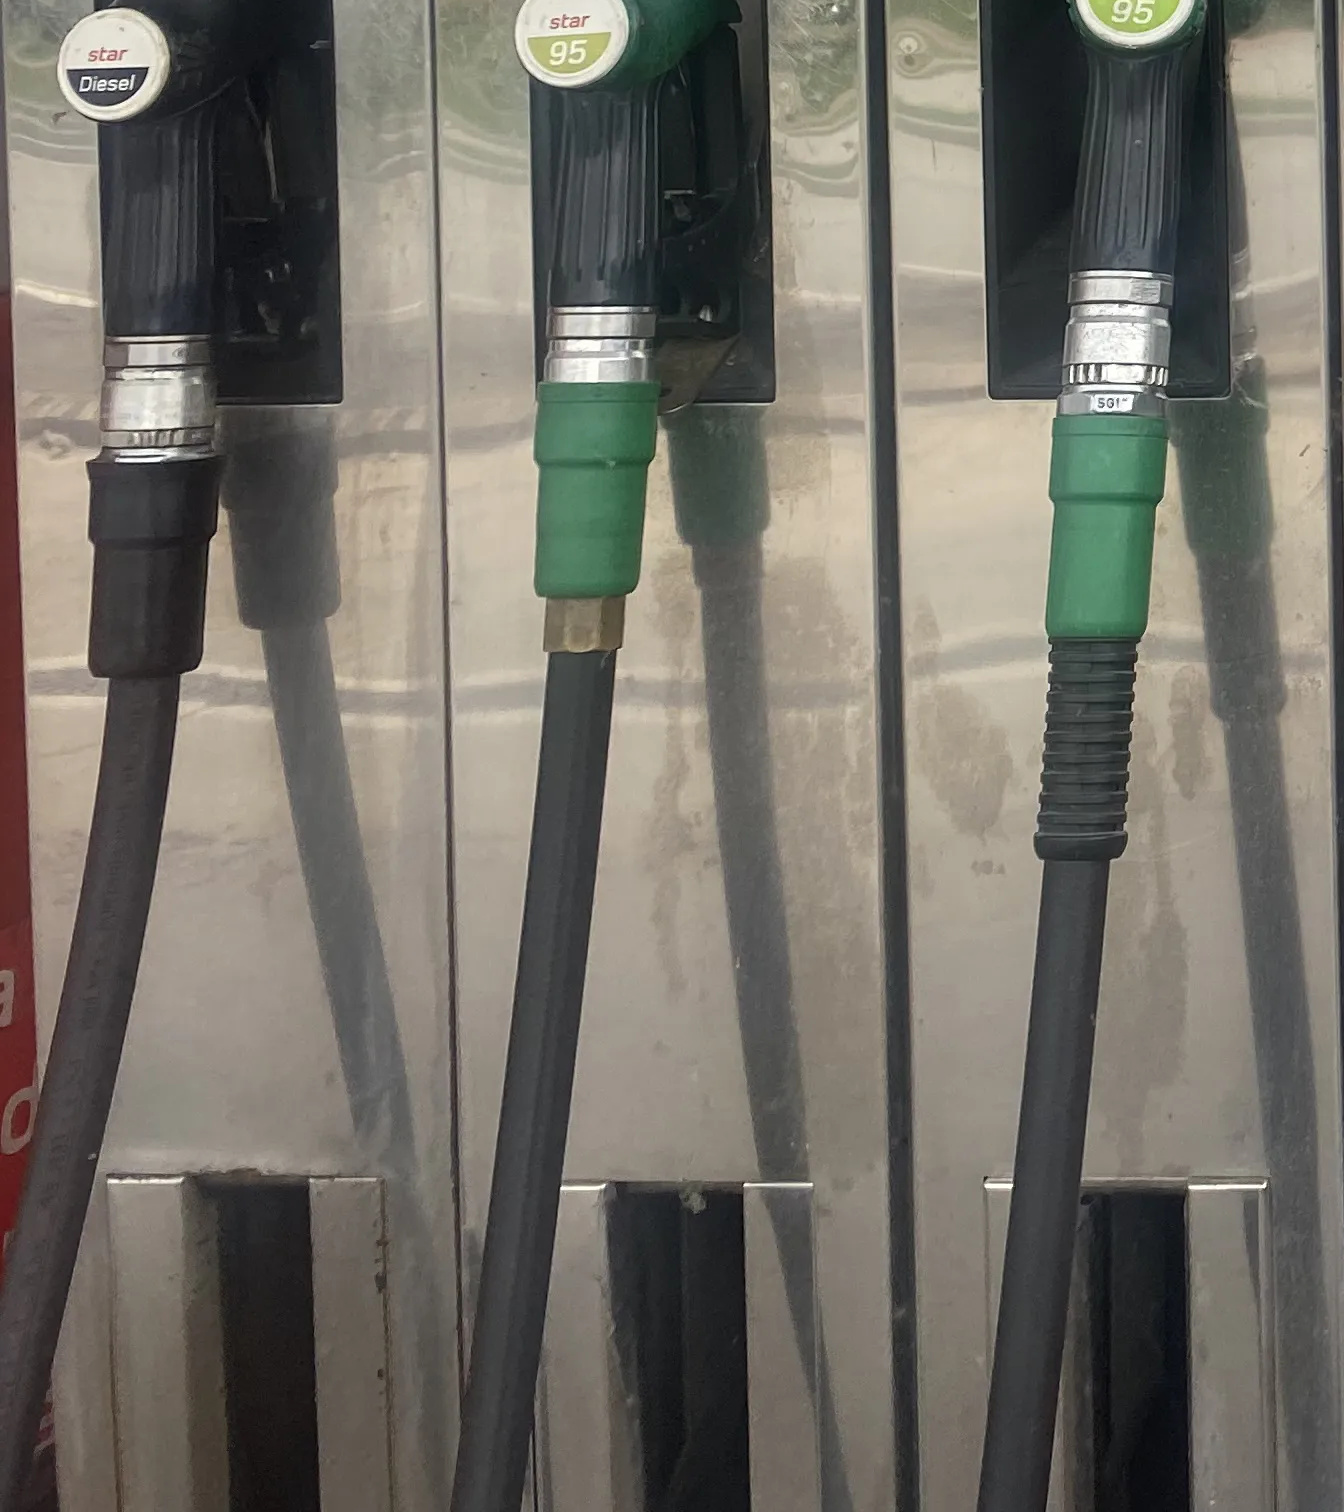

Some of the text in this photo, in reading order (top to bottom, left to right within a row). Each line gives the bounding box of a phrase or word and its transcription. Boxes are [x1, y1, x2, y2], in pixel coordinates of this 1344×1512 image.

[548, 13, 591, 29] star
[87, 47, 128, 62] star
[548, 39, 588, 66] 95
[79, 74, 136, 92] Diesel
